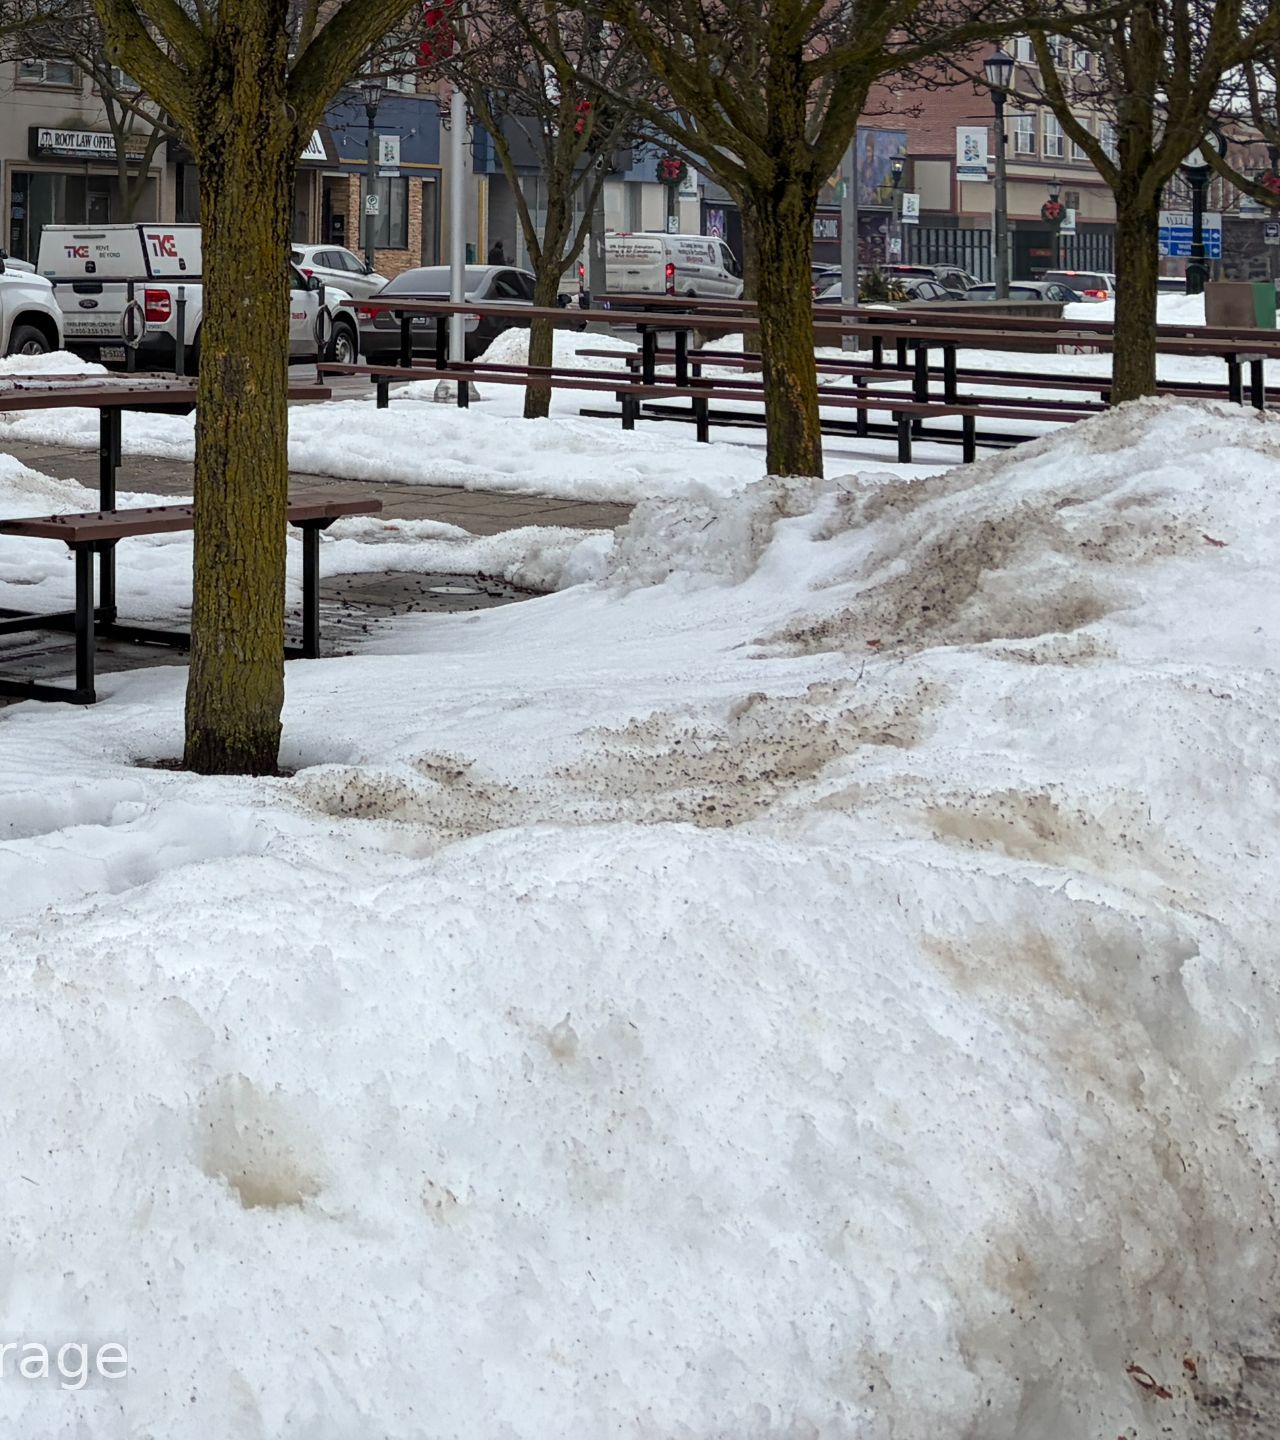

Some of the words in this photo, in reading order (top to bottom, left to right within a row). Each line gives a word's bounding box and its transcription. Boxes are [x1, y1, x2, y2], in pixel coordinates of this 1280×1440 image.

[54, 132, 75, 146] ROOT
[76, 134, 93, 148] LAW
[93, 135, 116, 149] OFFIC
[64, 246, 89, 258] TKE
[147, 234, 178, 257] TKE
